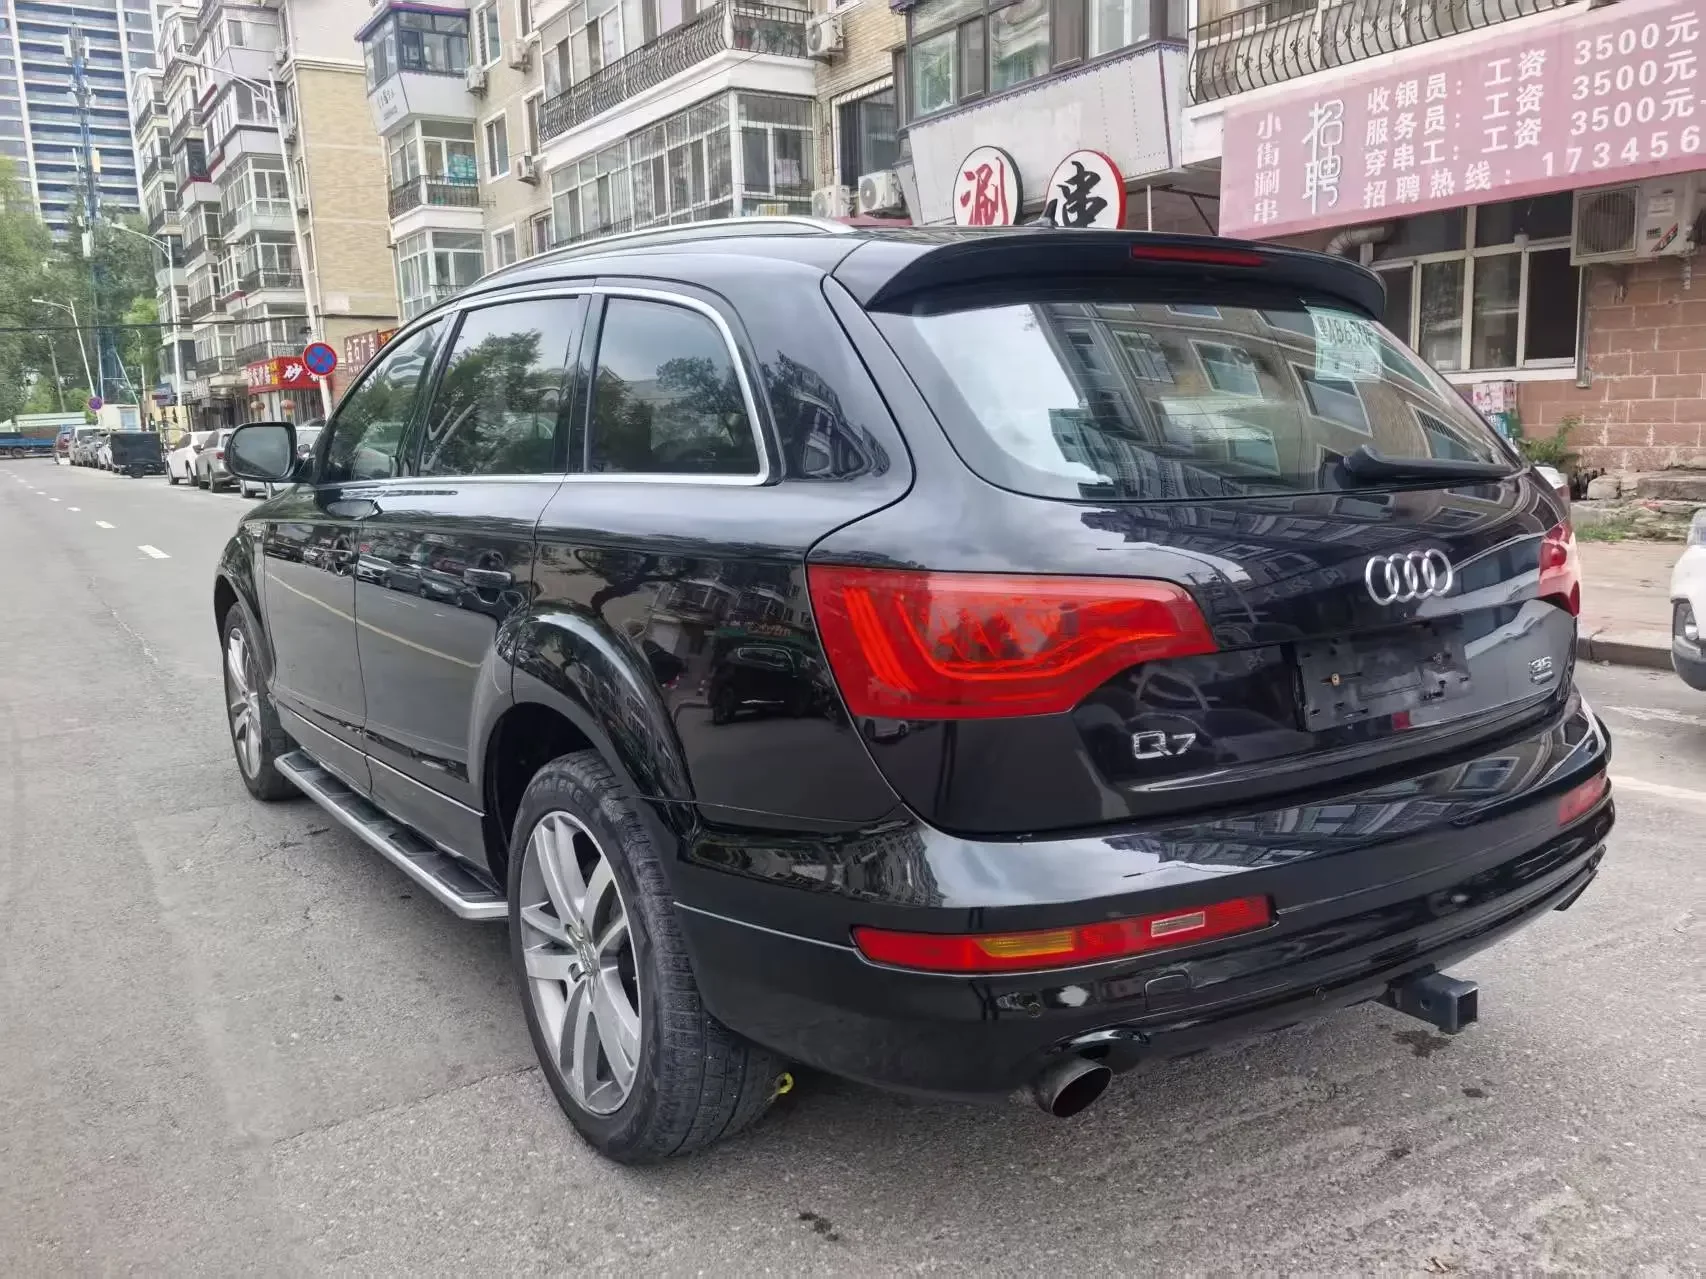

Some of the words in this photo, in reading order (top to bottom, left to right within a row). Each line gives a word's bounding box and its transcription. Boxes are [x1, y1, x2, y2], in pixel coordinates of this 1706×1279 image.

[1481, 83, 1545, 121] 工资
[1571, 49, 1698, 101] 3500元
[1484, 49, 1548, 88] 工资
[1573, 11, 1700, 66] 3500元
[1480, 117, 1543, 153] 工资
[1569, 86, 1696, 136] 3500元
[1302, 98, 1345, 215] 招聘
[1131, 730, 1197, 760] Q7
